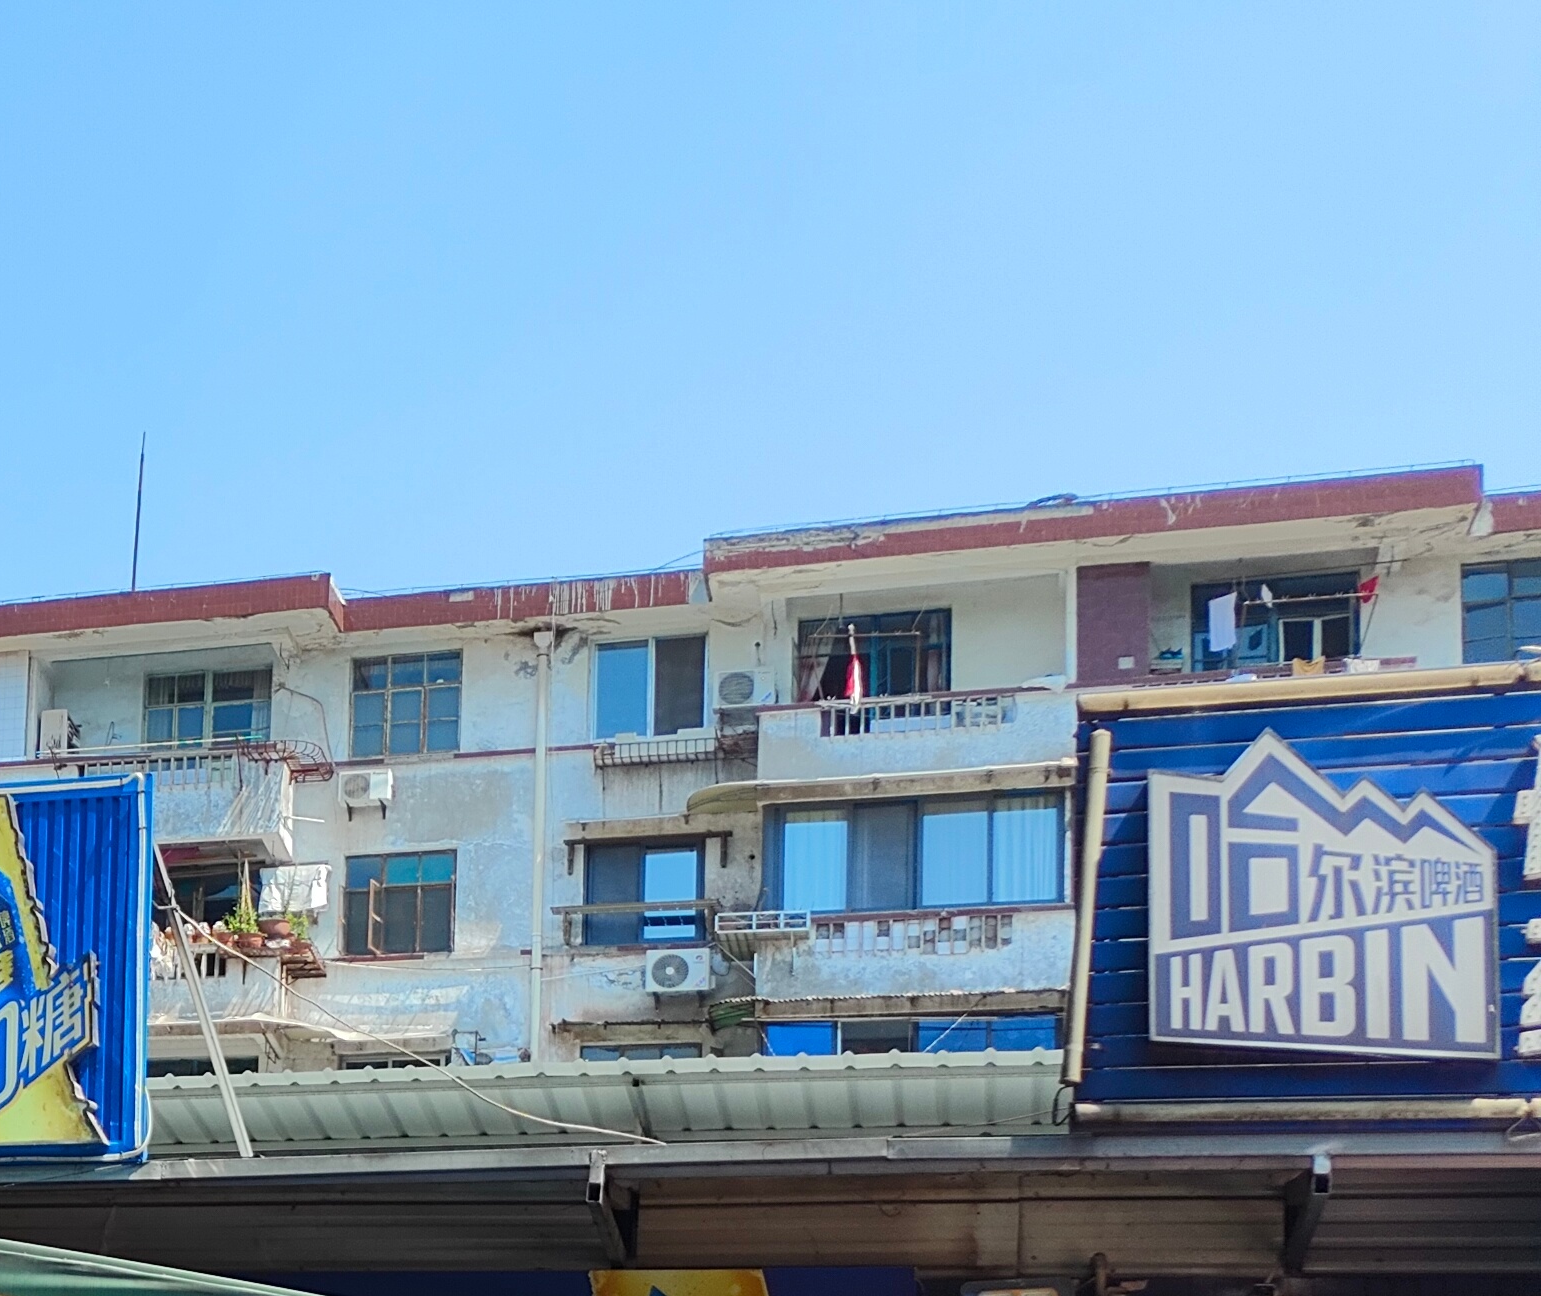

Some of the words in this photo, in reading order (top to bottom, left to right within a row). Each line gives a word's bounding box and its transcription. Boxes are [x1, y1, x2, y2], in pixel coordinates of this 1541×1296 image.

[1169, 752, 1485, 940] 哈尔滨啤酒
[1169, 915, 1488, 1043] HARBIN
